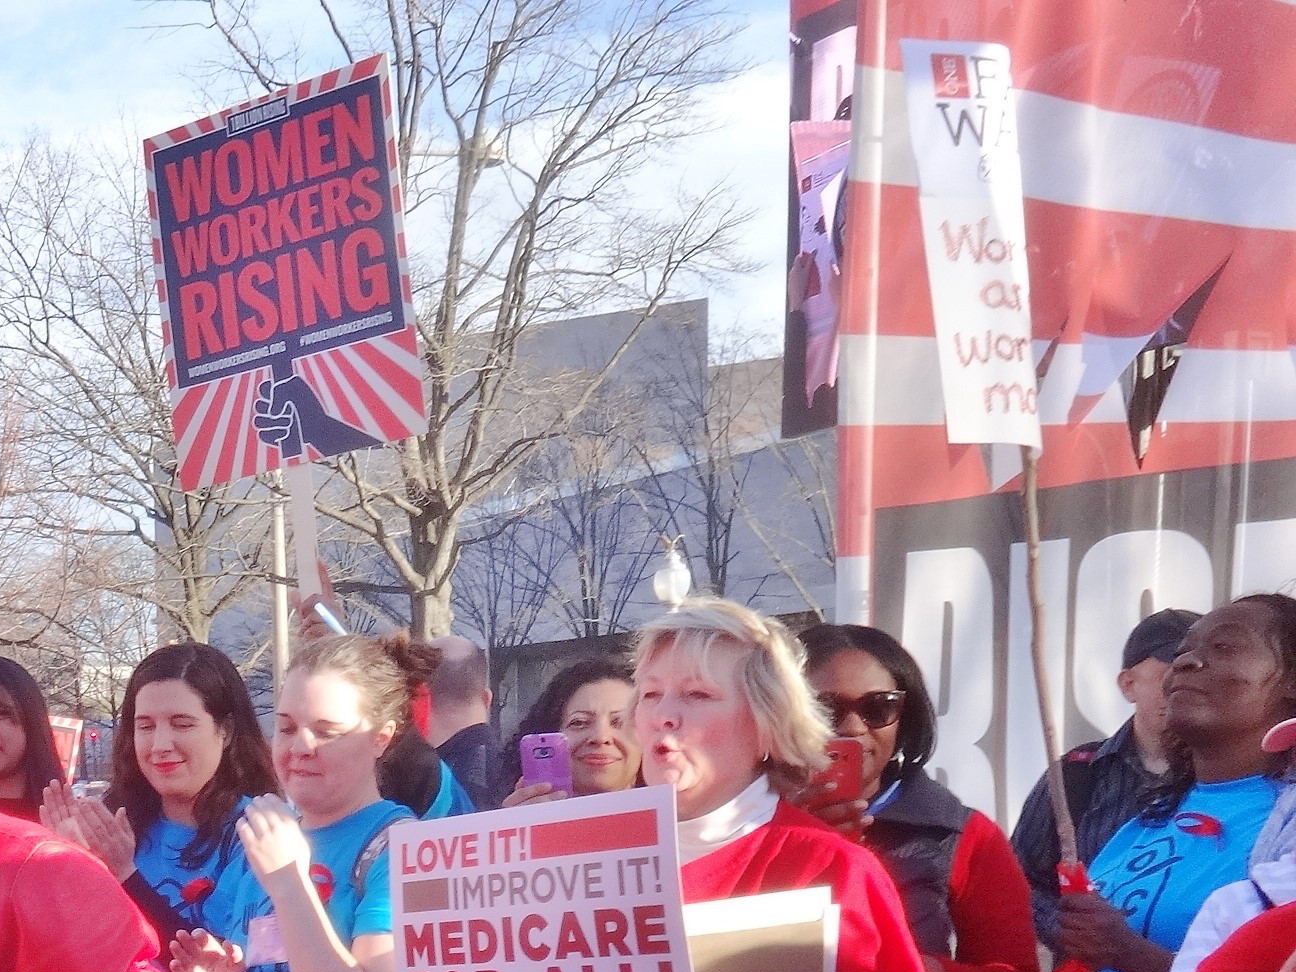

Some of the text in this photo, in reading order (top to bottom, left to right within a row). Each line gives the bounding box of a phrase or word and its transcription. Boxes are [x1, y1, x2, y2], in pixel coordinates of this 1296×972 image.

[164, 94, 375, 223] WOMEN
[170, 167, 384, 278] WORKERS
[179, 227, 391, 361] RISING
[900, 519, 1296, 836] RIS
[401, 826, 527, 875] LOVE IT!
[453, 856, 662, 910] IMPROVE IT!
[403, 904, 671, 968] MEDICARE
